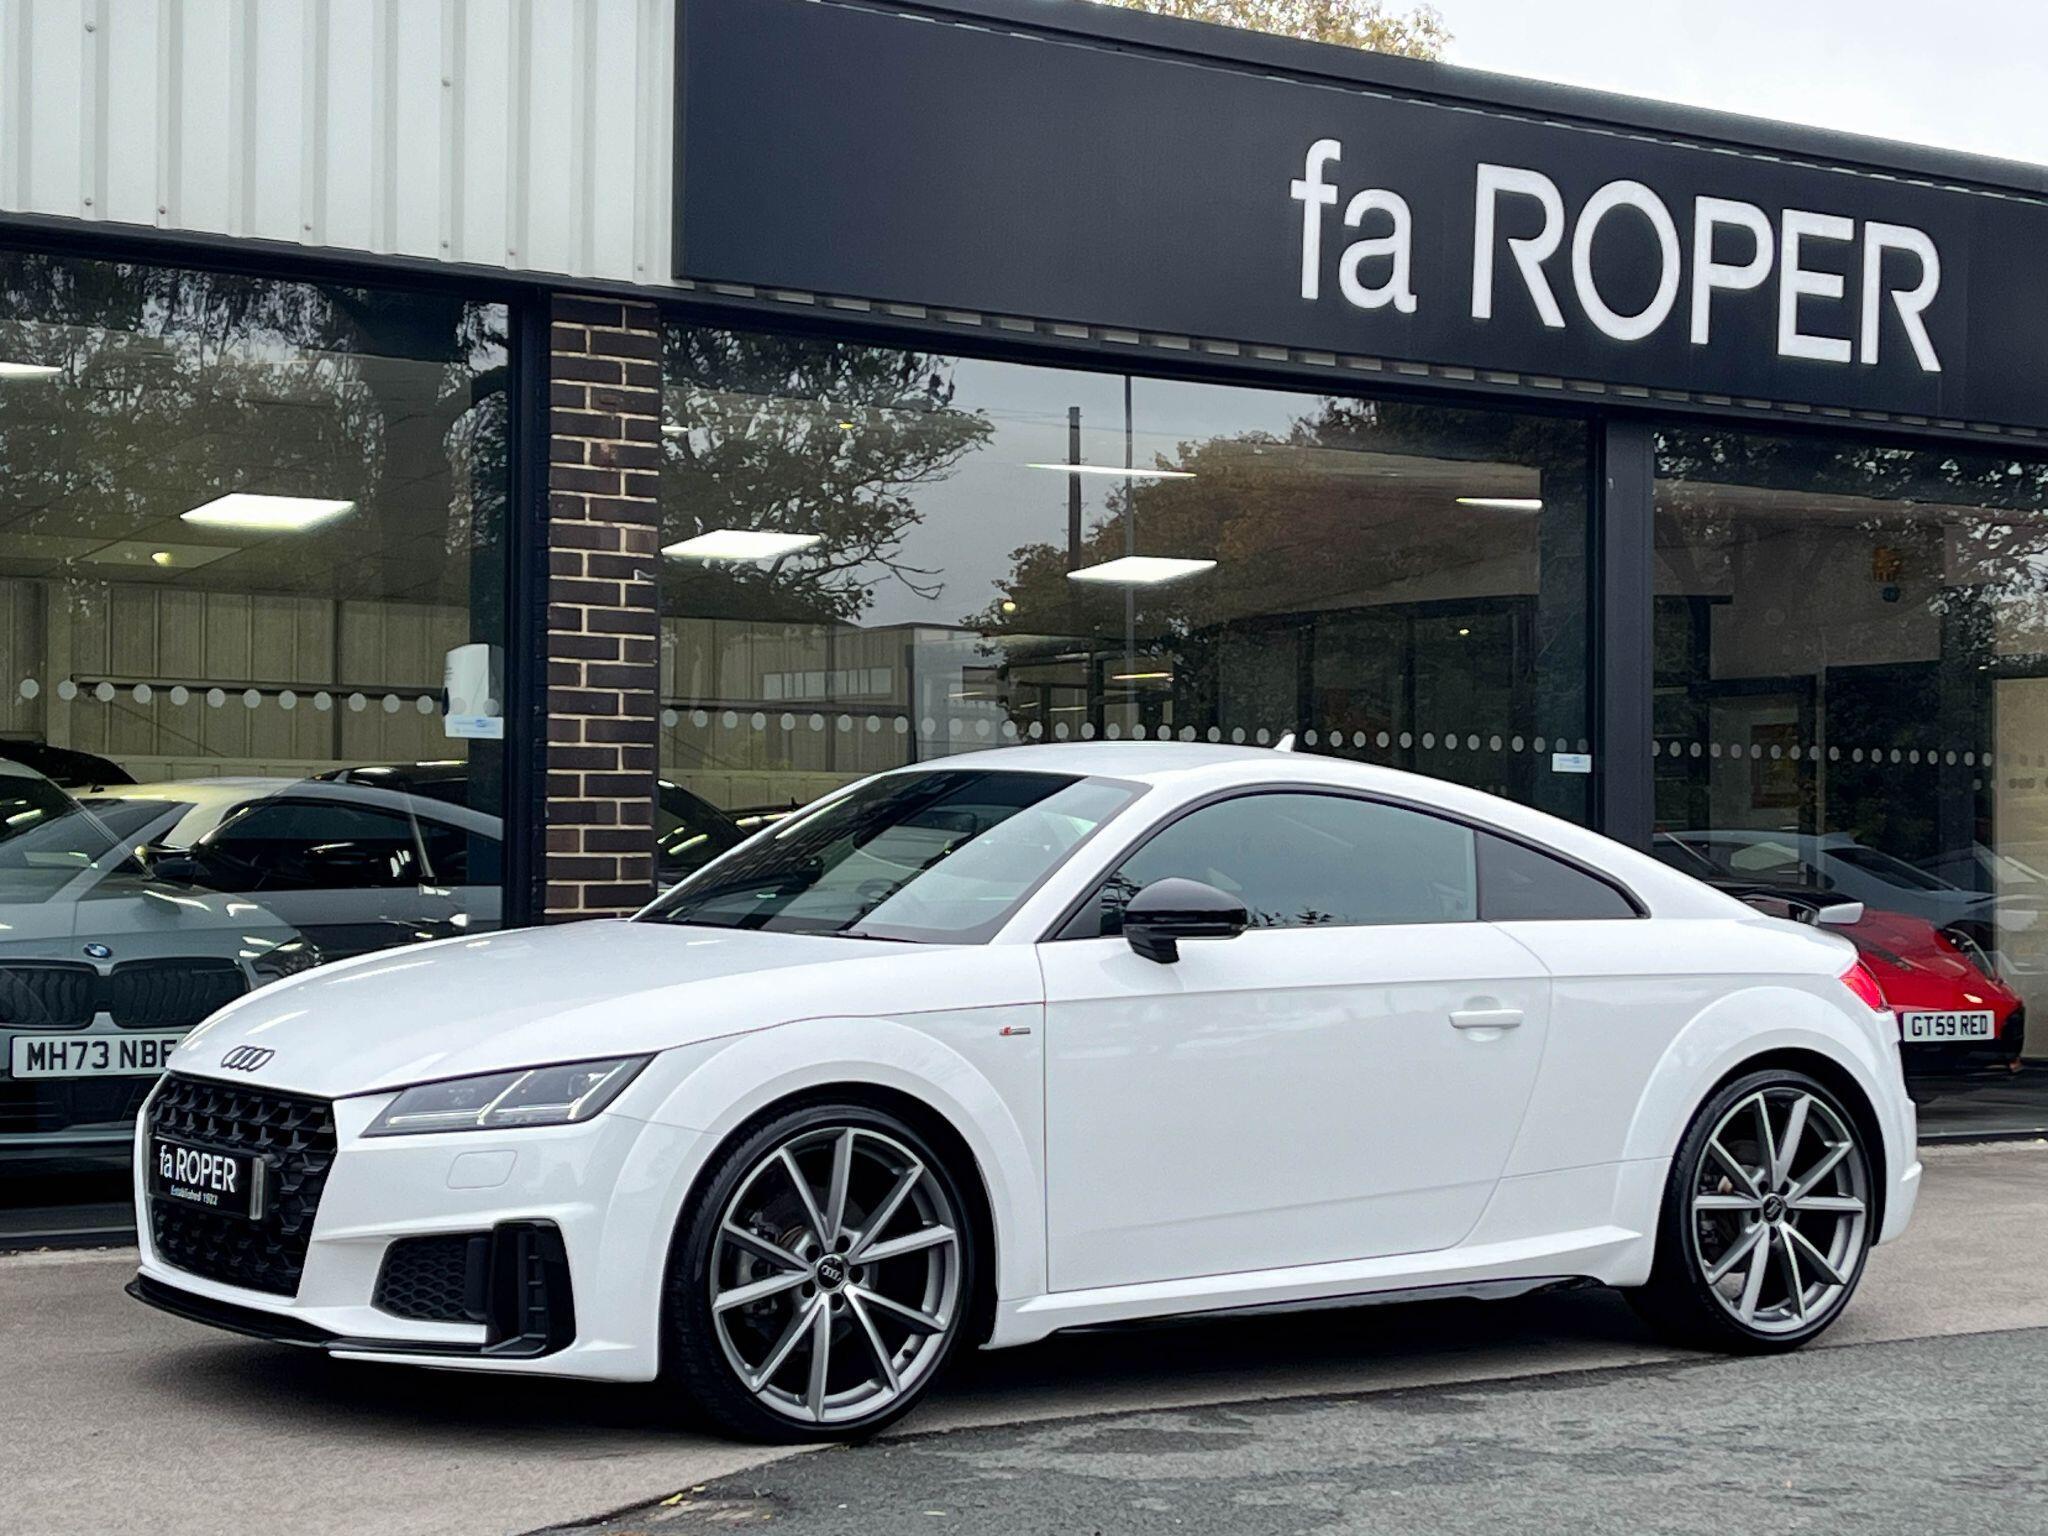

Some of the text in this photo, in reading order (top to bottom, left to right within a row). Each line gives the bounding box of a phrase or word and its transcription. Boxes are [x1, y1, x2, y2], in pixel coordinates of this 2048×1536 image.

[1289, 138, 1942, 373] fa ROPER
[1911, 1014, 1988, 1037] GT59 RED
[26, 1041, 109, 1071] MH73
[159, 1144, 237, 1193] fa ROPER
